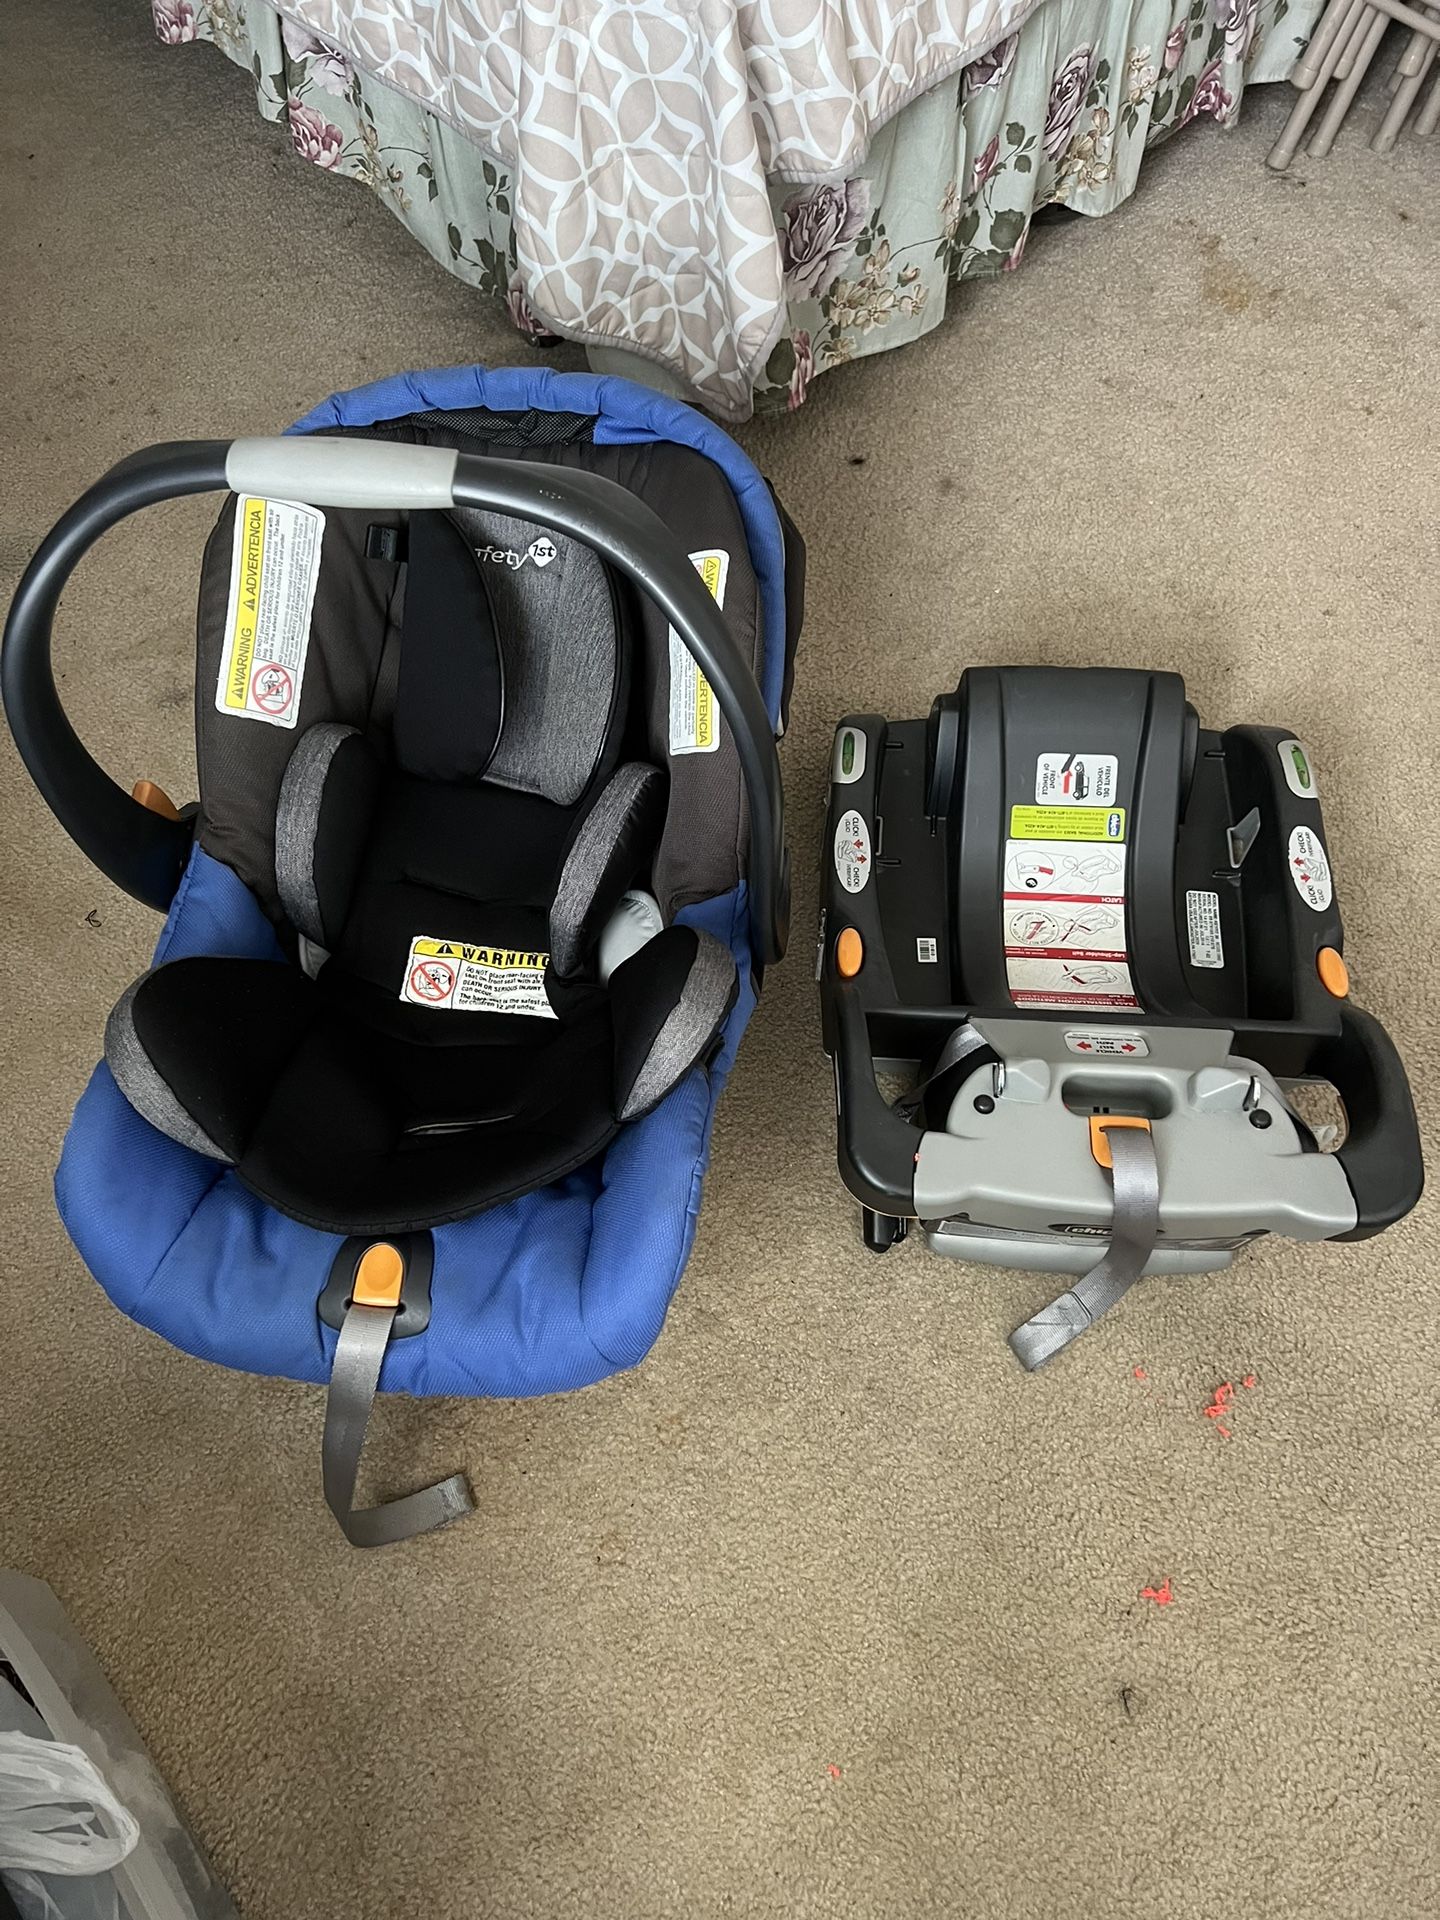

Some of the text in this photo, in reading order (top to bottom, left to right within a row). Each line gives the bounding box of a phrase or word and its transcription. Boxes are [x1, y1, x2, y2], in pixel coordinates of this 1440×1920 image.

[246, 510, 262, 595] ADVERTENCIA
[475, 544, 555, 571] fety 1st
[266, 615, 271, 623] OR
[234, 628, 252, 686] WARNING
[255, 648, 261, 656] DO
[699, 674, 707, 742] ERTENCIA
